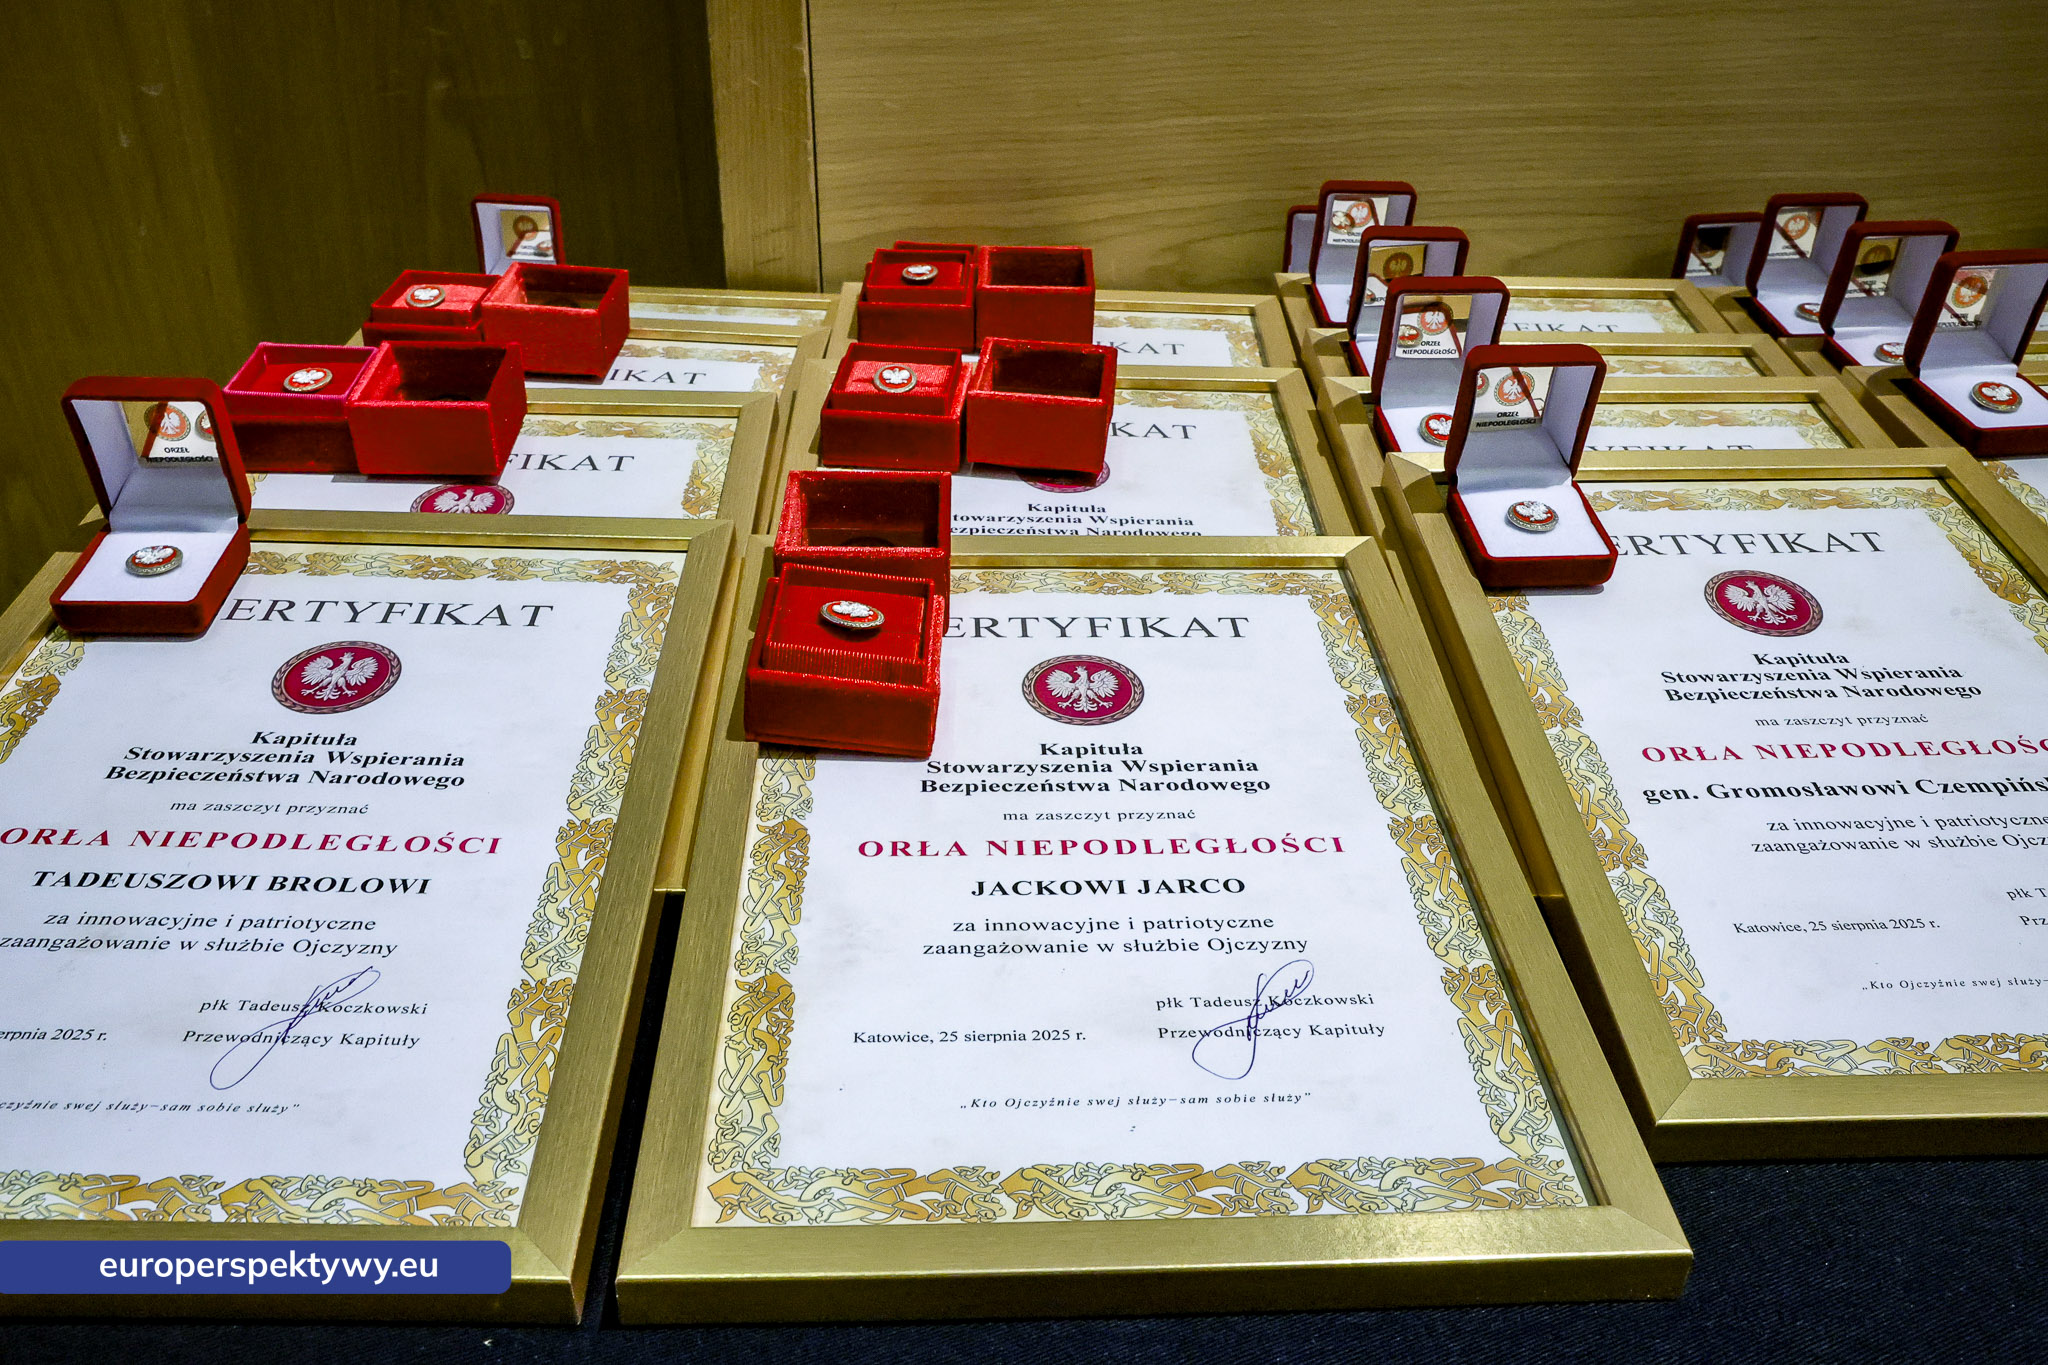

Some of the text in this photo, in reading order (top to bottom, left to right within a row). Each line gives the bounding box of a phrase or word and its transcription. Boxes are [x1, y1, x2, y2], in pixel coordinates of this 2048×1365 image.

[1027, 503, 1106, 515] Kapituła
[953, 514, 1194, 527] towarzyszenia Wspierania
[1609, 531, 1885, 556] ERTYFIKAT
[220, 598, 554, 627] ERTYFIKAT
[943, 616, 1251, 639] ERTYFIKAT
[1752, 652, 1850, 668] Kapituła
[1660, 666, 1963, 685] Stowarzyszenia Wspierania
[1664, 684, 1982, 704] Bezpieczeństwa Narodowego
[1754, 713, 1929, 727] ma zaszczyt przyznać
[251, 731, 358, 749] Kapituła
[123, 746, 465, 769] Stowarzyszenia Wspierania
[1040, 742, 1144, 759] Kapituła
[1641, 745, 1743, 762] ORŁA
[926, 759, 1259, 777] Stowarzyszenia Wspierania
[104, 765, 465, 790] Bezpieczeństwa Narodowego
[920, 778, 1271, 797] Bezpieczeństwa Narodowego
[1642, 776, 2048, 805] gen. Gromosławowi Czempińs
[169, 802, 369, 816] ma zaszczyt przyznać
[1003, 809, 1196, 823] ma zaszczyt przyznać
[1766, 822, 1790, 832] za
[1792, 816, 1917, 832] innowacyjne
[1919, 815, 1931, 828] i
[0, 827, 500, 854] ORŁA NIEPODLEGŁOŚCI
[858, 832, 1344, 857] ORŁA NIEPODLEGŁOŚCI
[1751, 836, 1900, 855] zaangażowanie
[1903, 839, 1921, 849] w
[1927, 834, 1998, 849] służbie
[32, 870, 430, 894] TADEUSZOWI BROLOWI
[971, 878, 1246, 897] JACKOWI JARCO
[2006, 888, 2034, 901] płk
[43, 911, 377, 934] za innowacyjne i patriotyczne
[952, 916, 1274, 934] za innowacyjne i patriotyczne
[1733, 918, 1941, 934] Katowice, 25 sierpnia 2025 r.
[0, 935, 398, 959] zaangażowanie w służbie Ojczyzny
[922, 937, 1308, 958] zaangażowanie w służbie Ojczyzny
[1971, 977, 2001, 989] swej
[198, 999, 428, 1016] płk Tadeusz Koczkowski
[1156, 993, 1375, 1012] płk Tadeusz Koczkowski
[50, 1028, 95, 1041] 2025
[96, 1032, 107, 1041] r.
[182, 1028, 420, 1050] Przewodniczący Kapituły
[853, 1029, 1087, 1044] Katowice, 25 sierpnia 2025 r.
[1157, 1023, 1385, 1042] Przewodniczący Kapituły
[63, 1100, 102, 1113] swej
[196, 1102, 241, 1113] sobie
[1004, 1097, 1080, 1110] Ojczyźnie
[1086, 1096, 1121, 1108] swej
[1215, 1093, 1256, 1104] sobie
